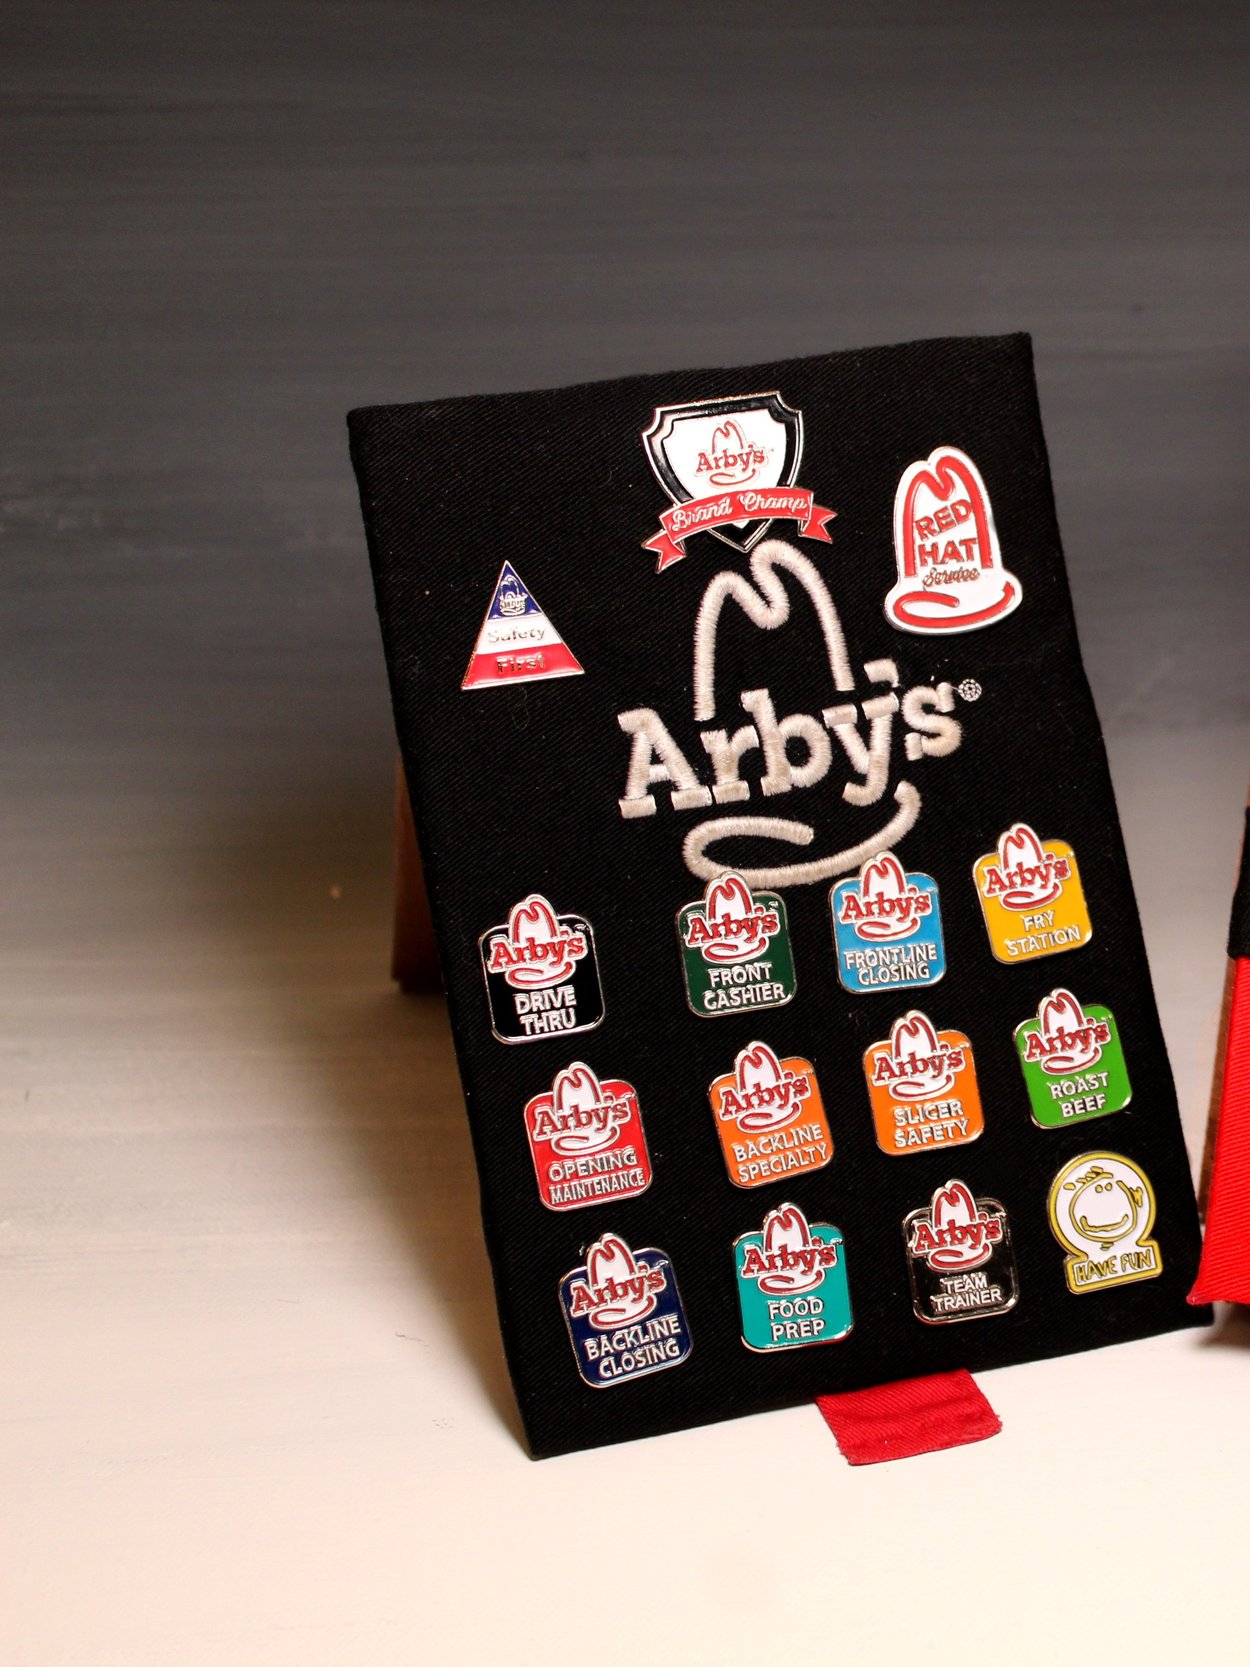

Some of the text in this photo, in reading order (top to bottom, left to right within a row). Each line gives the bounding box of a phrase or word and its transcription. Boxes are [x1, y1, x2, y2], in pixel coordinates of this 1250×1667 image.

[695, 444, 766, 473] Arby's
[671, 491, 808, 531] Brand Champ
[914, 499, 973, 541] RED
[917, 537, 978, 567] HAT
[922, 566, 980, 591] Service
[487, 625, 546, 644] Safety
[496, 652, 546, 673] First
[617, 657, 962, 819] Arby's
[986, 853, 1069, 895] Arby's
[842, 887, 931, 922] Arby's
[1022, 910, 1055, 932] FRY
[687, 906, 779, 945] Arby's
[1005, 924, 1081, 957] STATION
[491, 929, 585, 969] Arby's
[844, 943, 938, 970] FRONTLINE
[708, 962, 772, 988] FRONT
[858, 961, 930, 986] CLOSING
[514, 985, 578, 1015] DRIVE
[703, 982, 786, 1010] CASHIER
[520, 1008, 577, 1035] THRU
[1026, 1018, 1109, 1060] Arby's
[875, 1043, 964, 1082] Arby's
[721, 1071, 809, 1117] Arby's
[1049, 1072, 1109, 1100] ROAST
[536, 1094, 630, 1138] Arby's
[893, 1099, 964, 1127] SLICER
[1060, 1094, 1107, 1118] BEEF
[732, 1124, 824, 1162] BACKLINE
[894, 1117, 969, 1148] SAFETY
[549, 1146, 638, 1182] OPENING
[738, 1142, 828, 1183] SPECIALTY
[549, 1167, 646, 1205] MAINTENANCE
[915, 1212, 1001, 1251] Arby's
[743, 1237, 836, 1276] Arby's
[1075, 1249, 1152, 1283] HAVE FUN
[571, 1263, 666, 1315] Arby's
[931, 1287, 1003, 1312] TRAINER
[941, 1271, 988, 1295] TEAM
[768, 1295, 824, 1320] FOOD
[584, 1313, 681, 1361] BACKLINE
[771, 1317, 825, 1342] PREP
[599, 1338, 681, 1378] CLOSING
